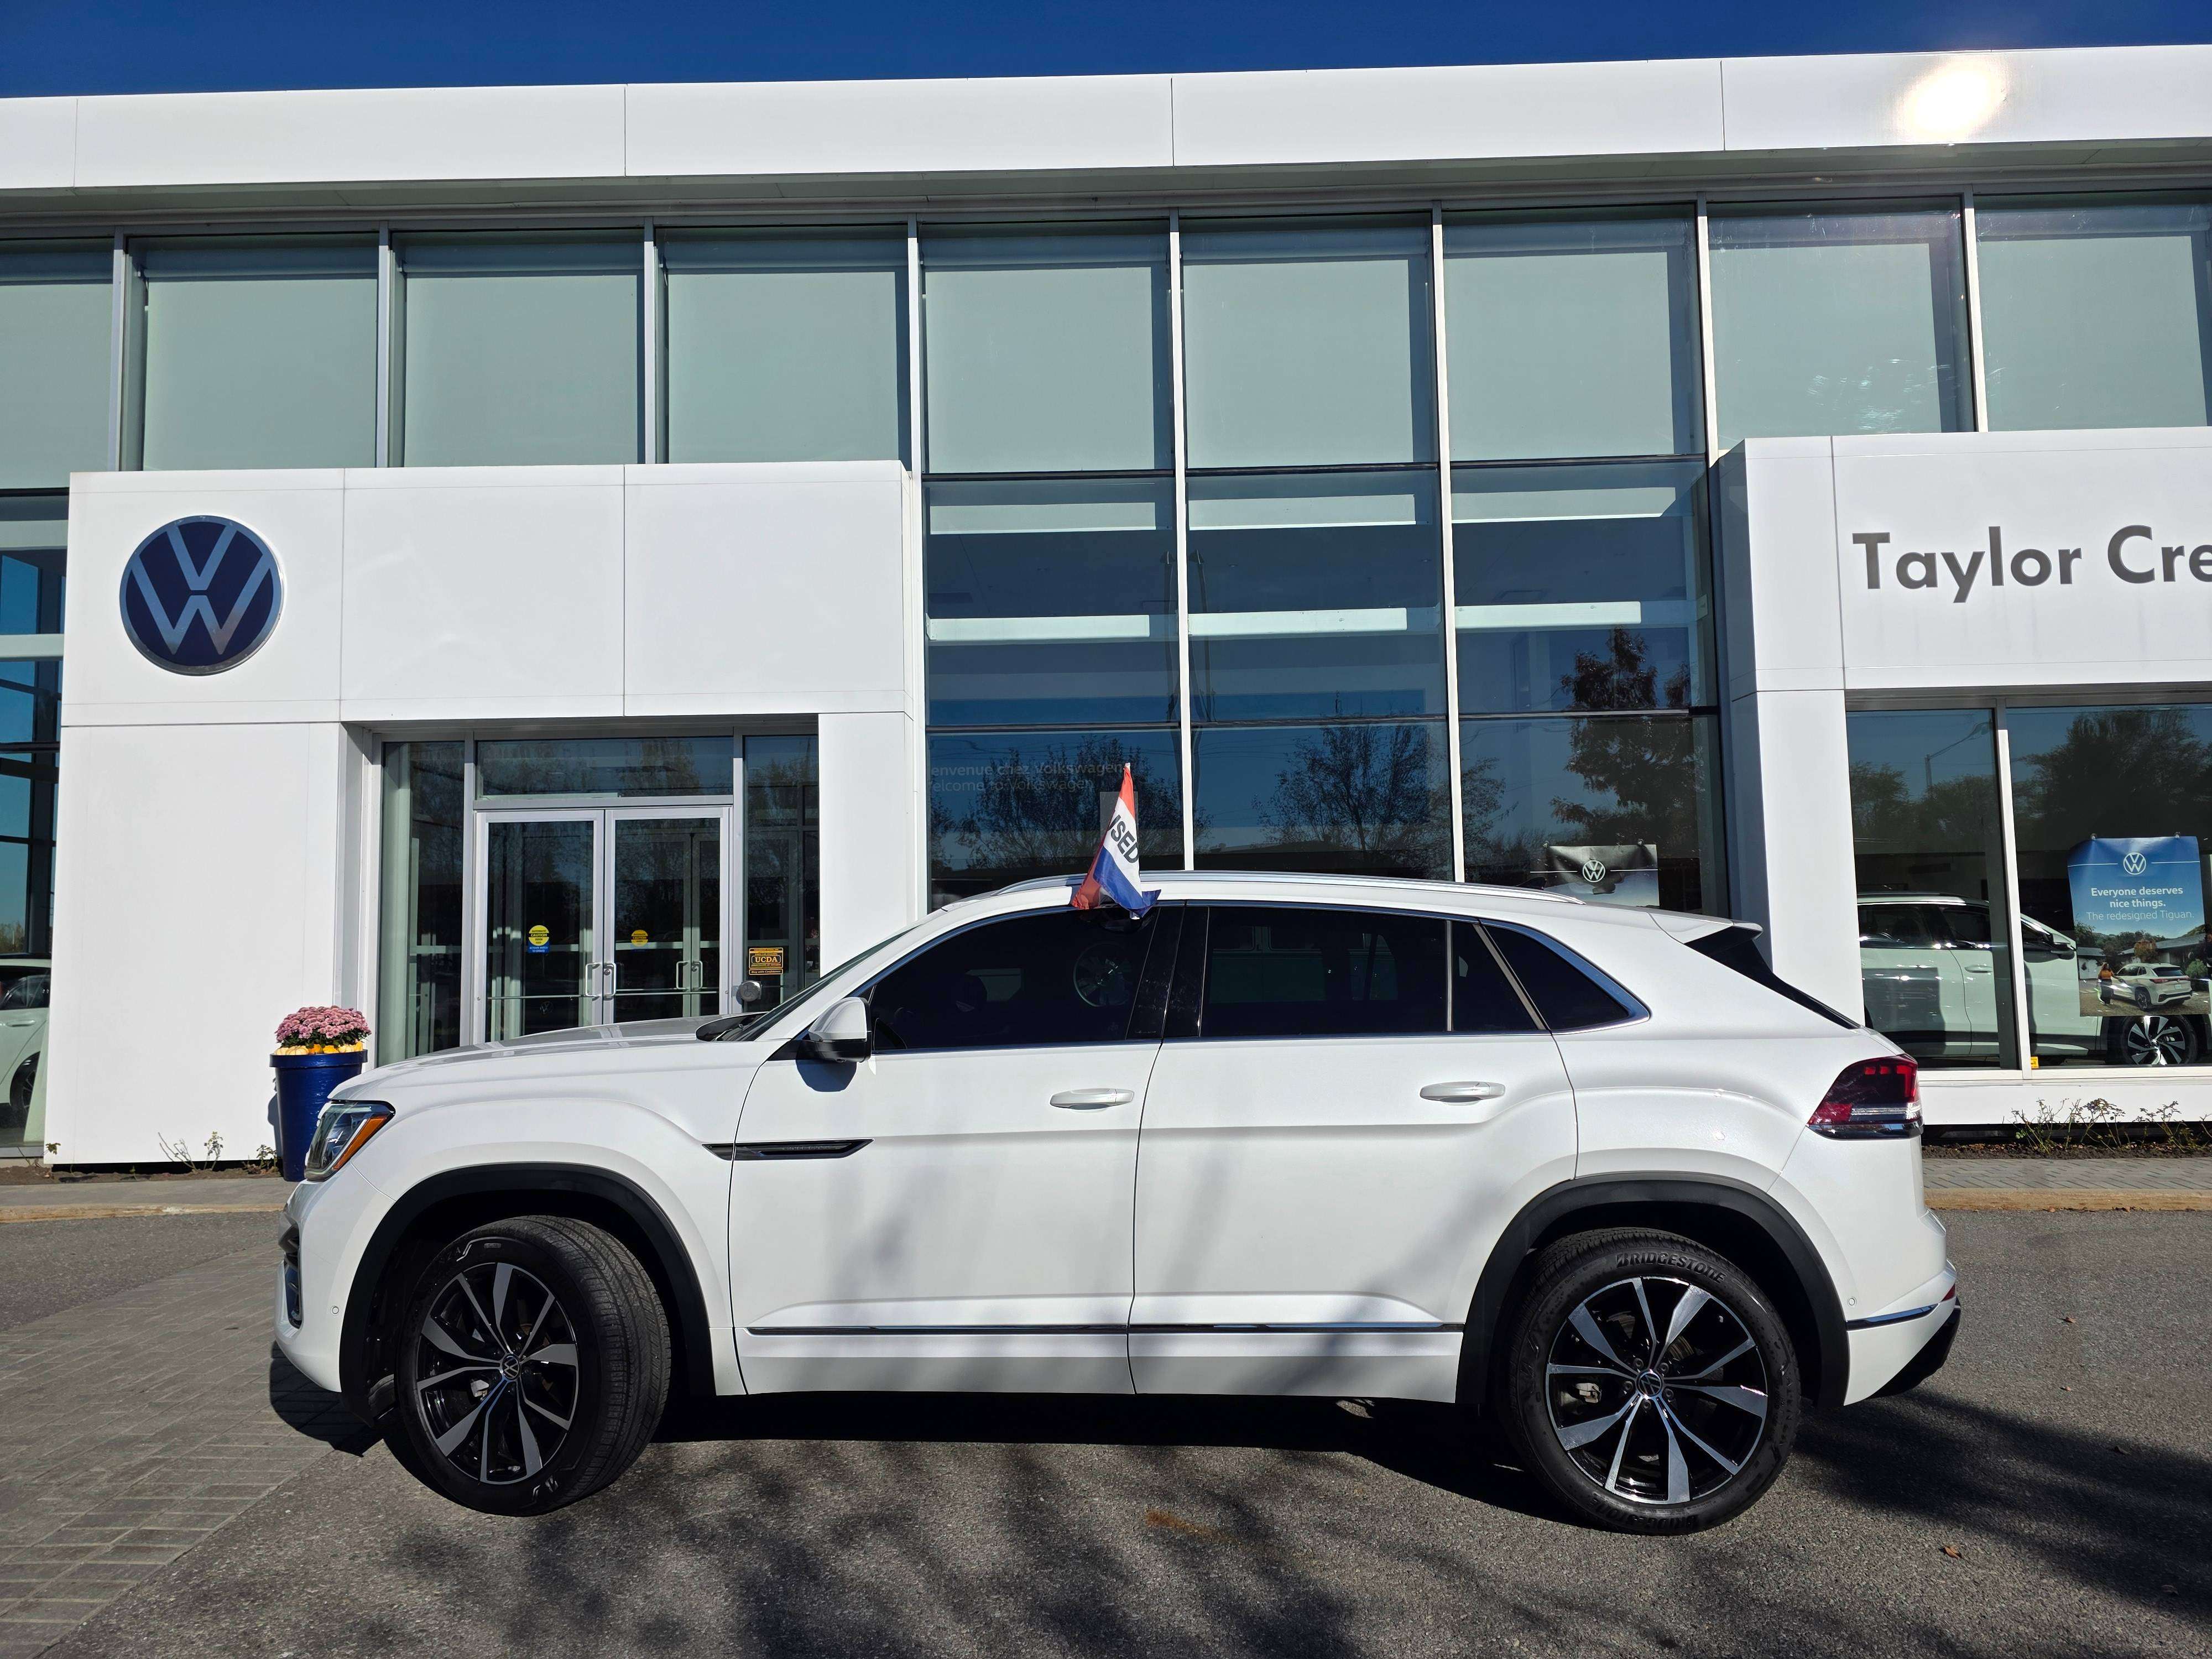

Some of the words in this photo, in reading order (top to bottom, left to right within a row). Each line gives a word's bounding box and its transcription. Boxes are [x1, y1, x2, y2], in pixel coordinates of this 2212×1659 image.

[1852, 526, 2082, 603] Taylor
[2107, 524, 2212, 584] Cre
[931, 766, 994, 776] envenue
[998, 764, 1029, 776] chez
[1035, 762, 1123, 777] Volkswagen
[928, 779, 984, 792] elcome
[989, 781, 1003, 791] to
[1006, 778, 1094, 793] Volkswagen
[2091, 887, 2137, 898] Everyone
[2138, 886, 2183, 895] deserves
[2110, 899, 2130, 908] nice
[2131, 898, 2166, 909] things.
[2086, 912, 2104, 921] The
[2106, 911, 2157, 922] redesigned
[2159, 910, 2194, 921] Tiguan.
[1616, 1251, 1728, 1284] BRIDGESTONE
